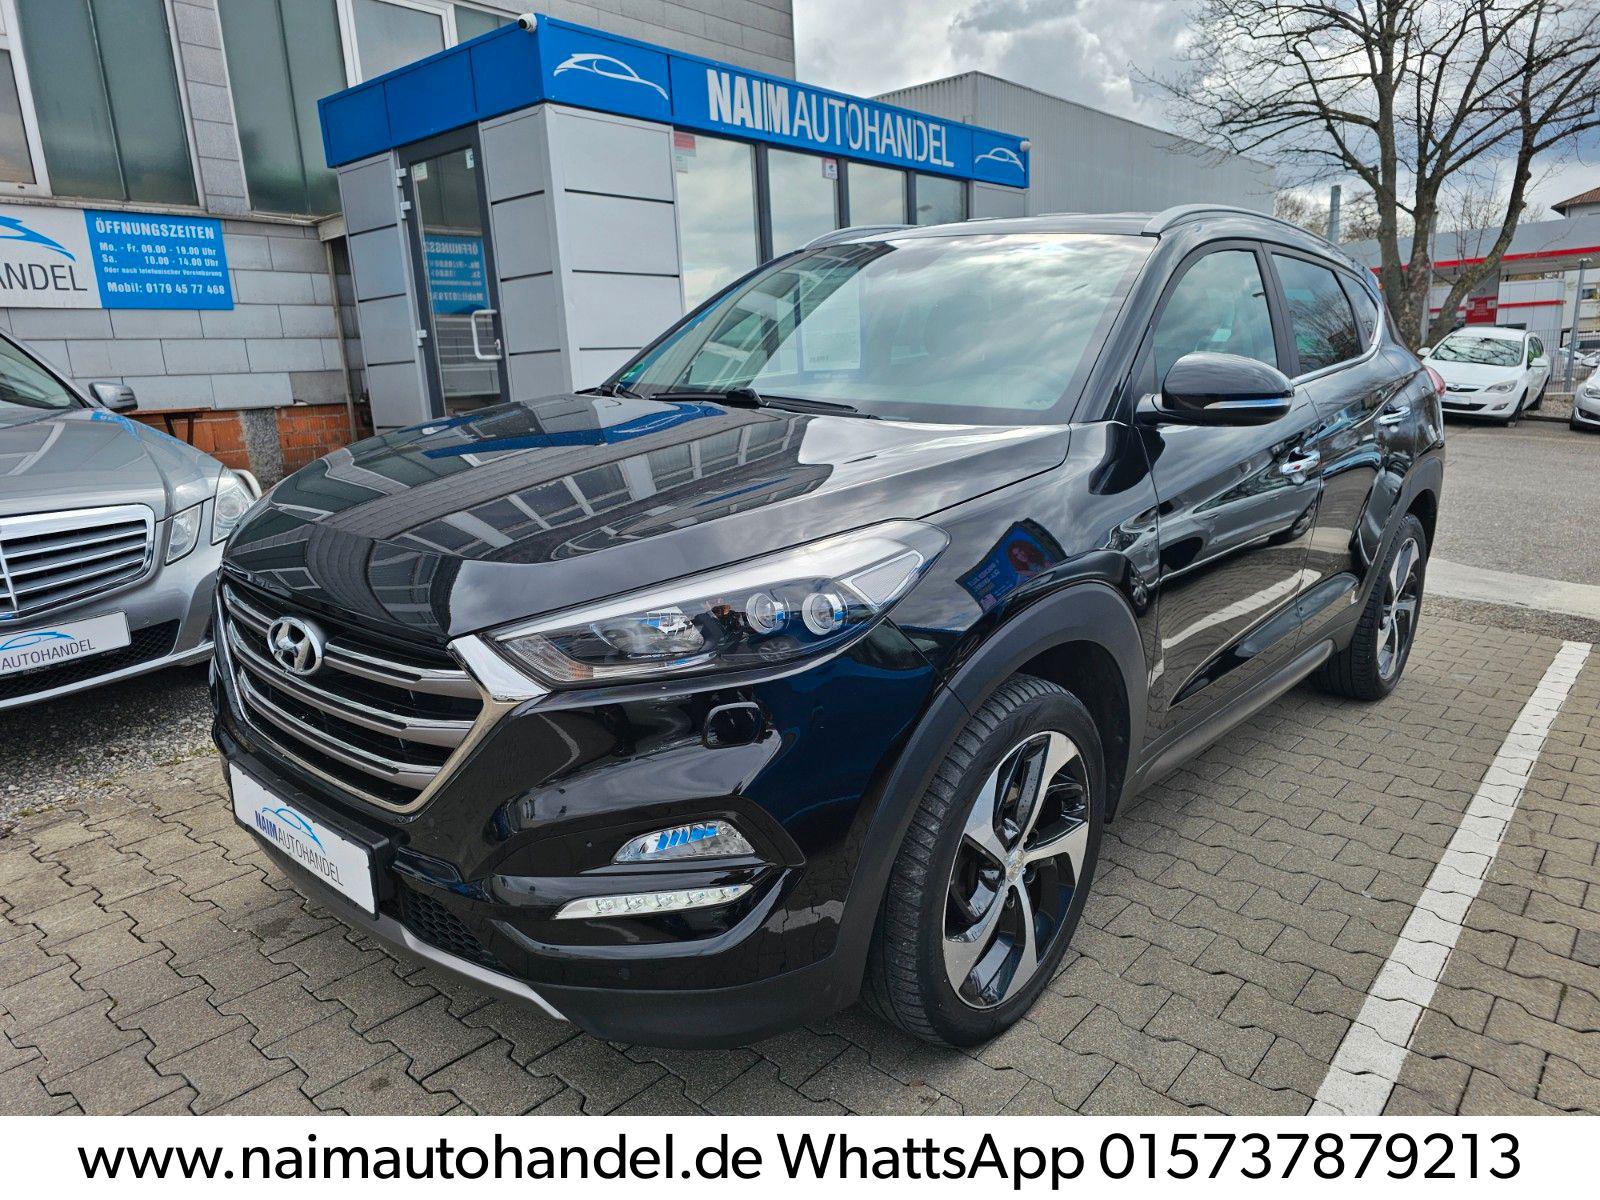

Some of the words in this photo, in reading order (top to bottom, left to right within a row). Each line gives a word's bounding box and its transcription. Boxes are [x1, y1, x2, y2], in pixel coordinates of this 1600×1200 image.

[95, 217, 215, 240] ÖFFNUNGSZEITEN
[99, 242, 118, 252] Mo.
[127, 243, 139, 253] Fr.
[176, 246, 200, 256] 19.00
[202, 247, 217, 256] Uhr
[101, 254, 118, 263] Sa.
[144, 256, 170, 265] 10.00
[178, 257, 202, 267] 14.00
[204, 258, 219, 267] Uhr
[0, 262, 88, 291] NDEL
[107, 281, 143, 294] Mobil:
[146, 282, 173, 294] 0179
[175, 283, 188, 294] 45
[191, 283, 203, 294] 77
[1, 638, 96, 670] AUTOHANDEL
